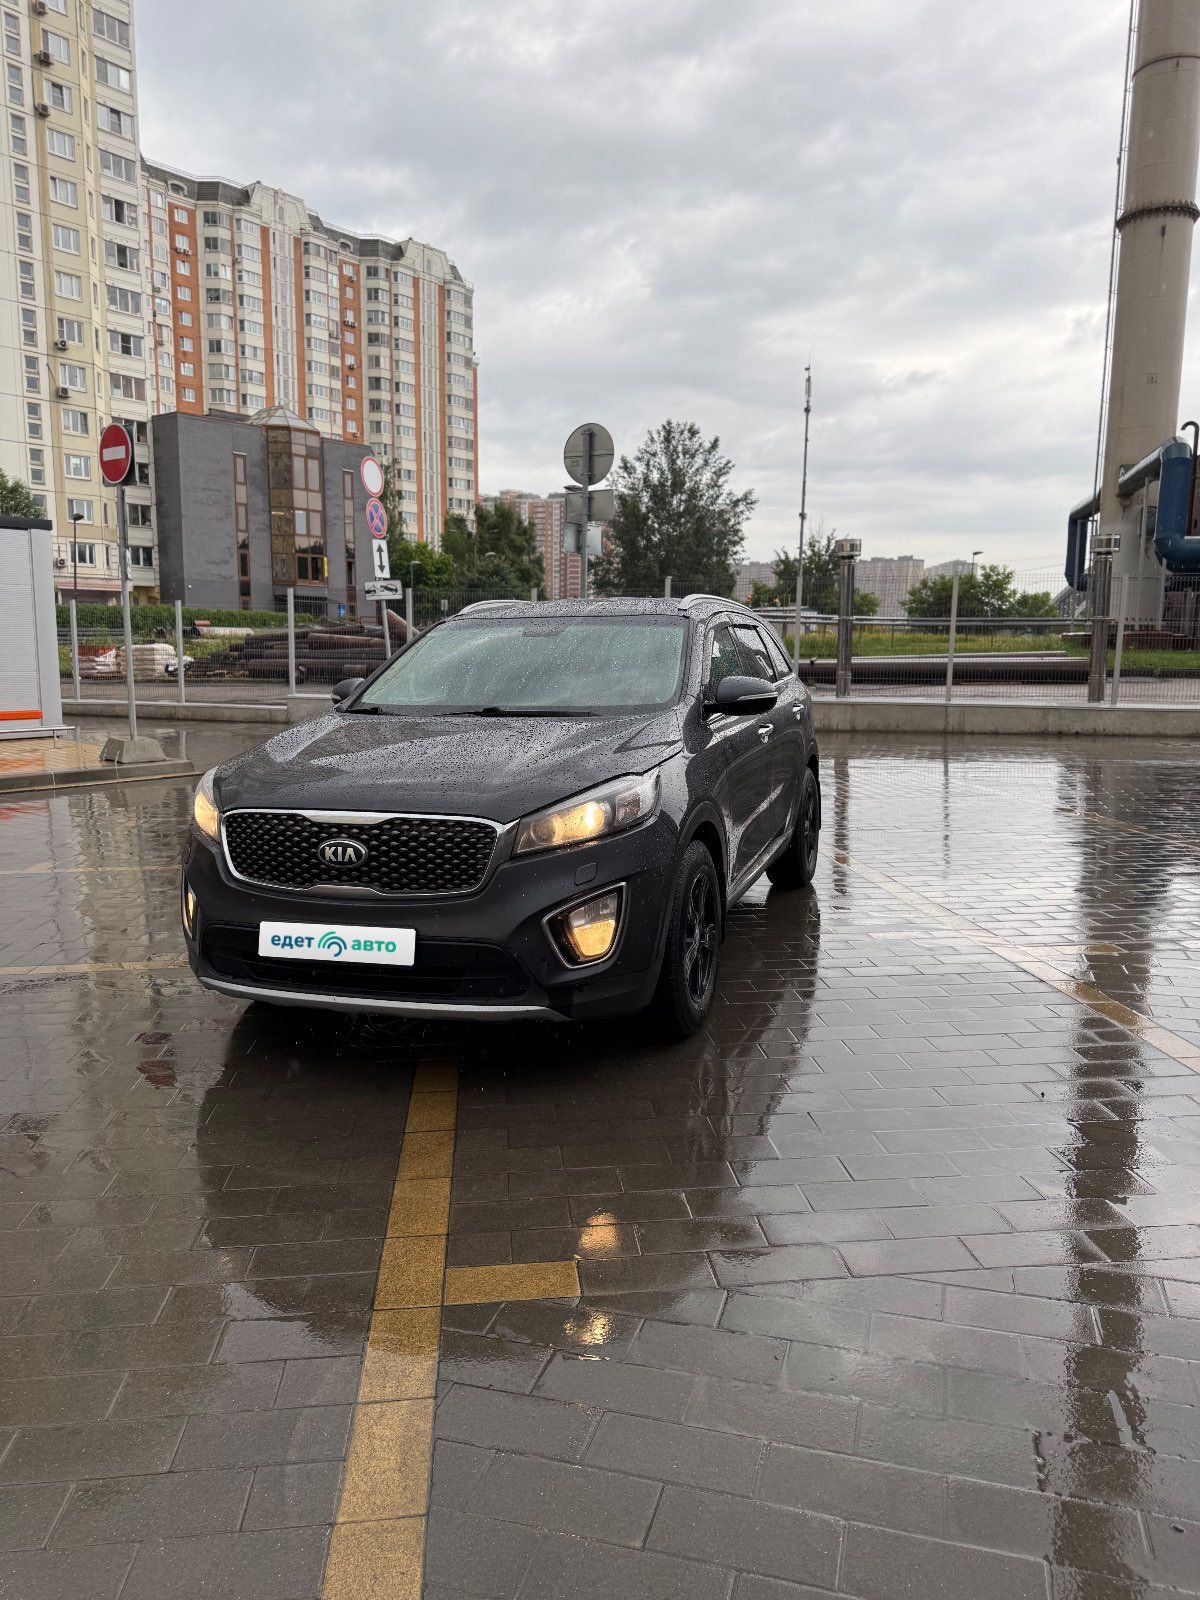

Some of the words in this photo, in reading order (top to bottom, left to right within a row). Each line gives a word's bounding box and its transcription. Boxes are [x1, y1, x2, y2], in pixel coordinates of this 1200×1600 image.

[324, 846, 357, 862] KIA
[271, 935, 314, 949] едет
[351, 938, 396, 953] авто
